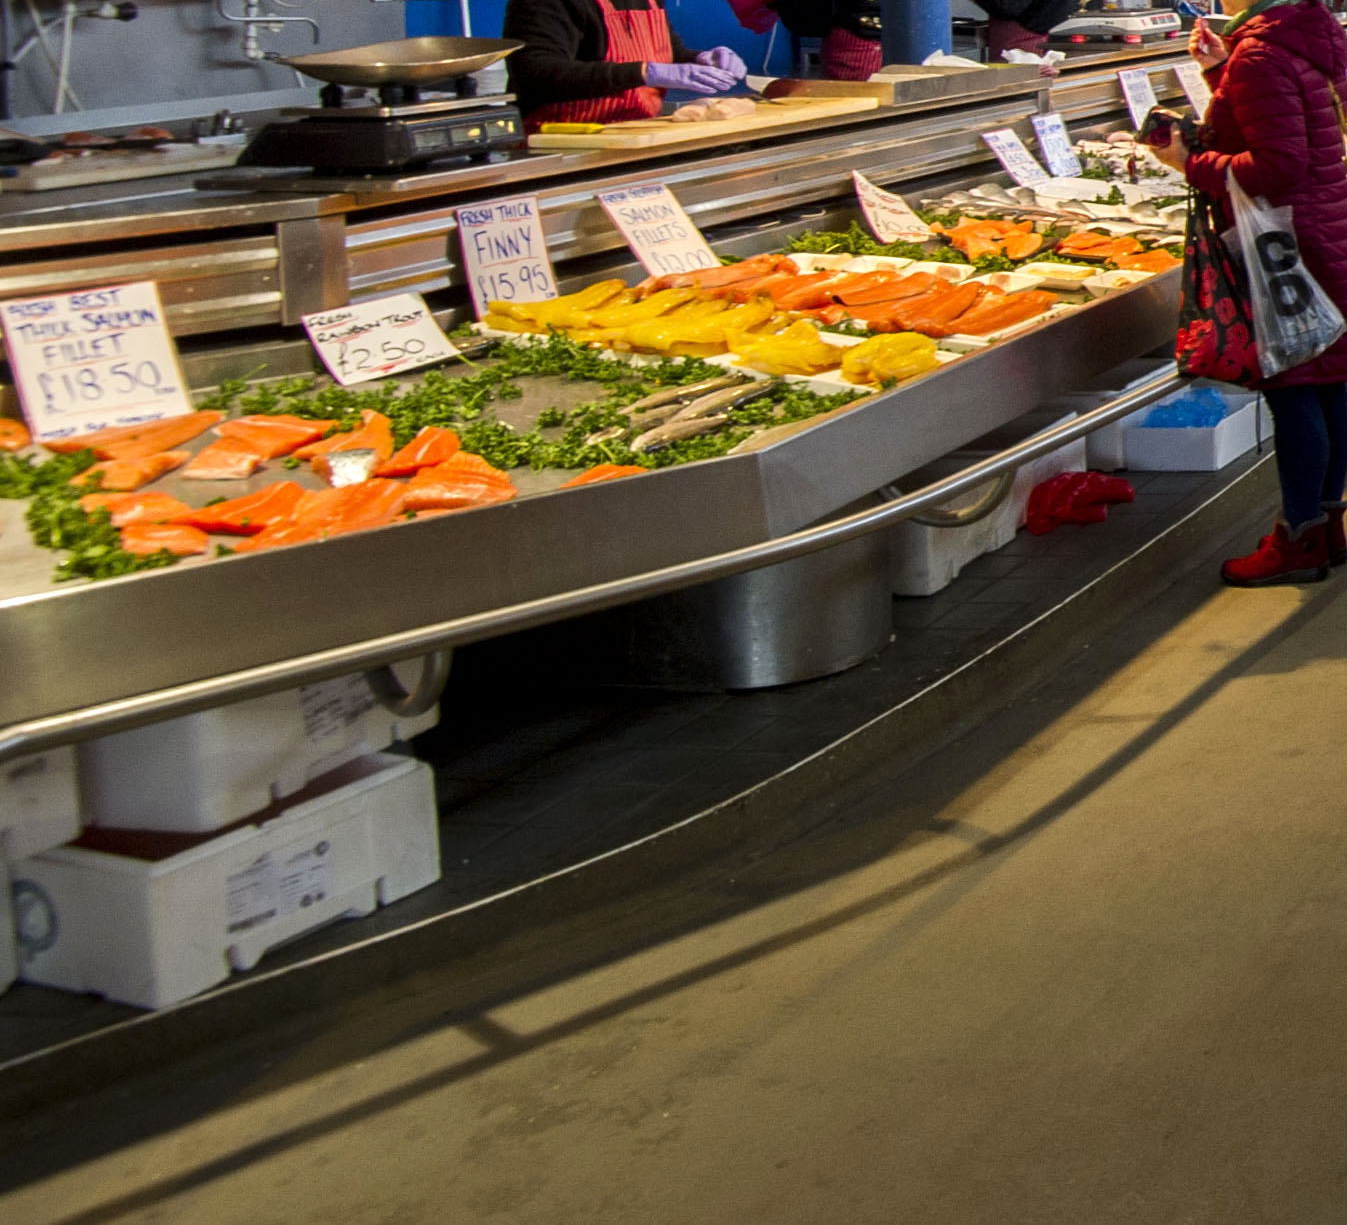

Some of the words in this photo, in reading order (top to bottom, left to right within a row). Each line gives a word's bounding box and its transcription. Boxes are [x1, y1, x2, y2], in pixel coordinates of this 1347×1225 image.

[461, 209, 494, 226] FRESH
[496, 202, 533, 221] THICK
[618, 201, 676, 225] SALMON
[473, 226, 532, 265] FINNY
[632, 222, 688, 247] FILLETS
[69, 289, 122, 311] BEST
[14, 321, 74, 342] THICK
[81, 308, 157, 333] SALMON
[307, 313, 353, 328] FRESH
[316, 320, 381, 343] RAINBOW
[382, 310, 424, 323] TROUT
[42, 332, 126, 365] FILLET
